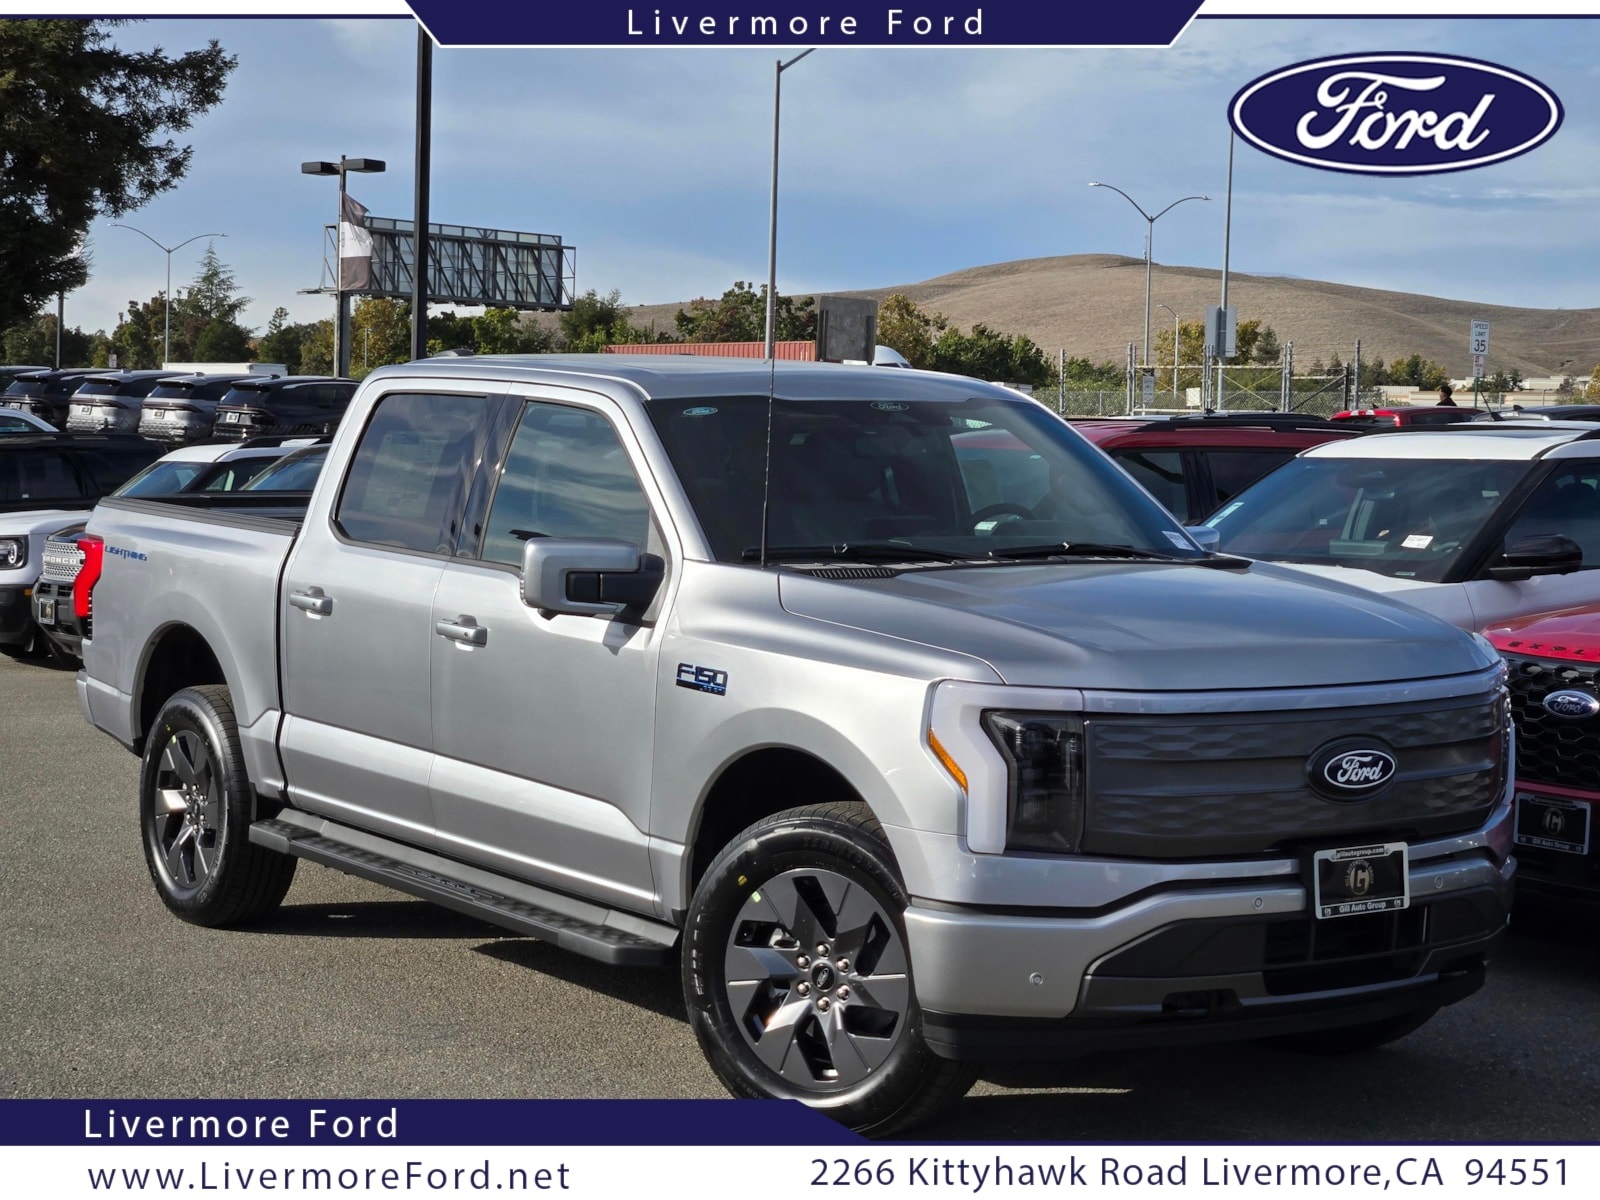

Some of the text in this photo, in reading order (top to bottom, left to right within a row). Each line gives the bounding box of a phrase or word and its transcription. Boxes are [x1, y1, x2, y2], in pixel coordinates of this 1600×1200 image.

[1473, 339, 1486, 353] 35
[105, 545, 148, 562] LIGHTNING
[676, 662, 728, 688] F-150
[1553, 695, 1585, 713] Ford
[1336, 755, 1384, 783] Ford
[1336, 847, 1384, 858] gillautogroup.com
[1339, 901, 1387, 913] Gill Auto Group
